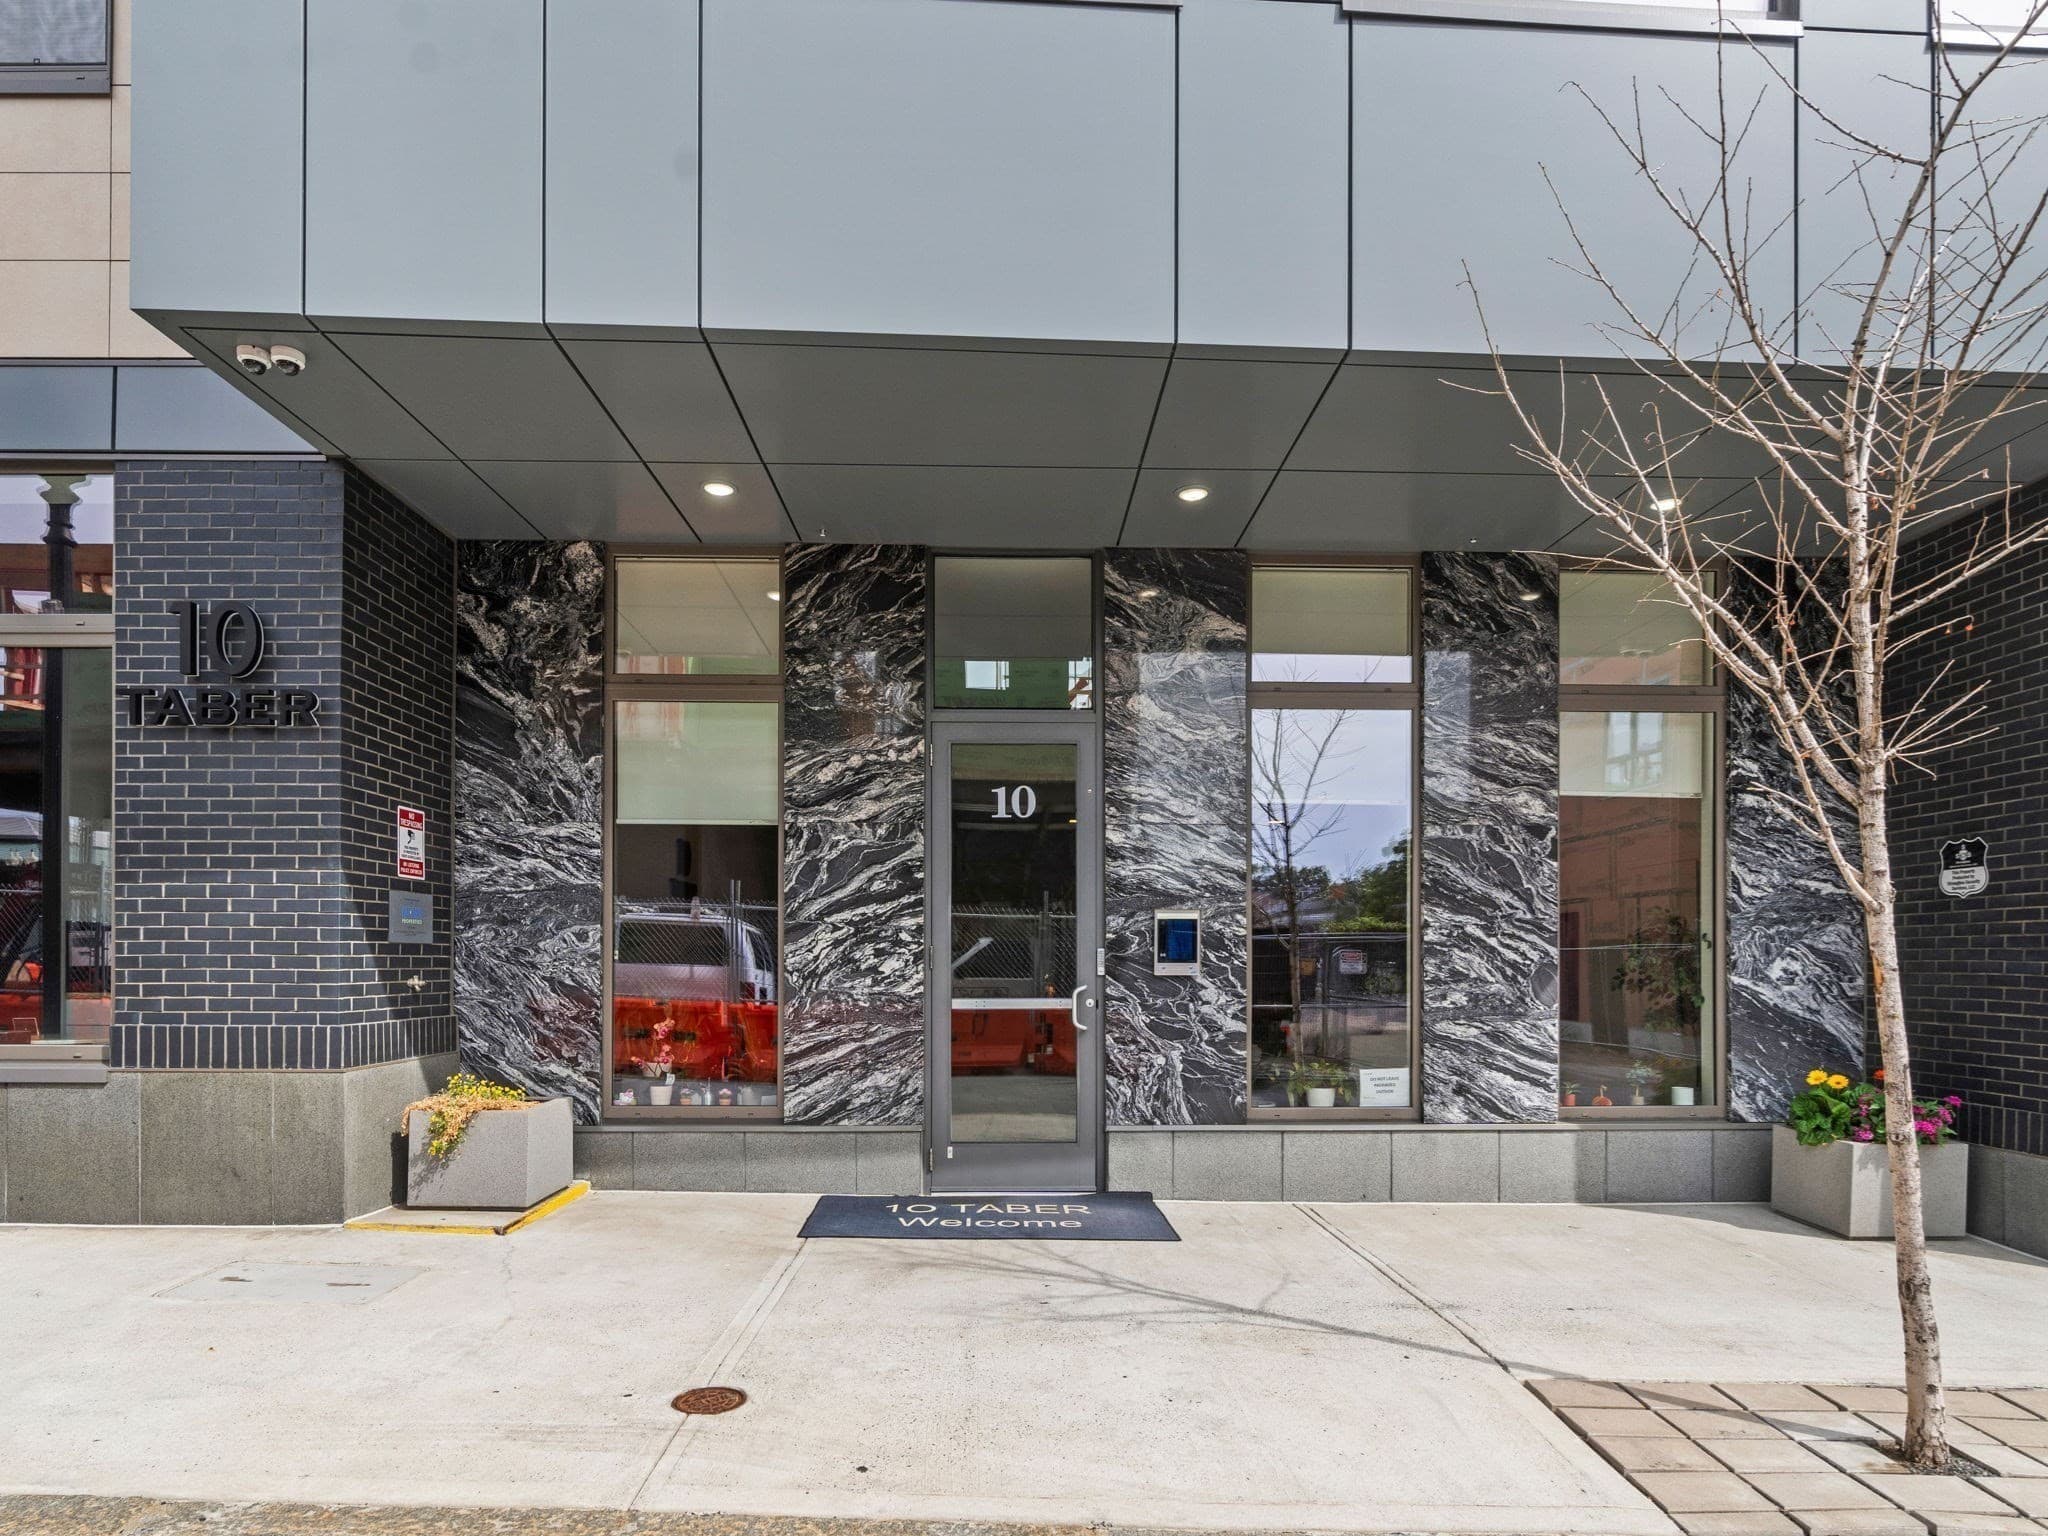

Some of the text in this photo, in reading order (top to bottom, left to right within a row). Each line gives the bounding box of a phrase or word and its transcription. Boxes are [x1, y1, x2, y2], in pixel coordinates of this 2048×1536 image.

[169, 601, 265, 679] 10
[116, 688, 321, 727] TABER
[991, 785, 1036, 818] 10
[886, 1203, 1091, 1214] 10 TABER
[899, 1217, 1082, 1228] Welcome
